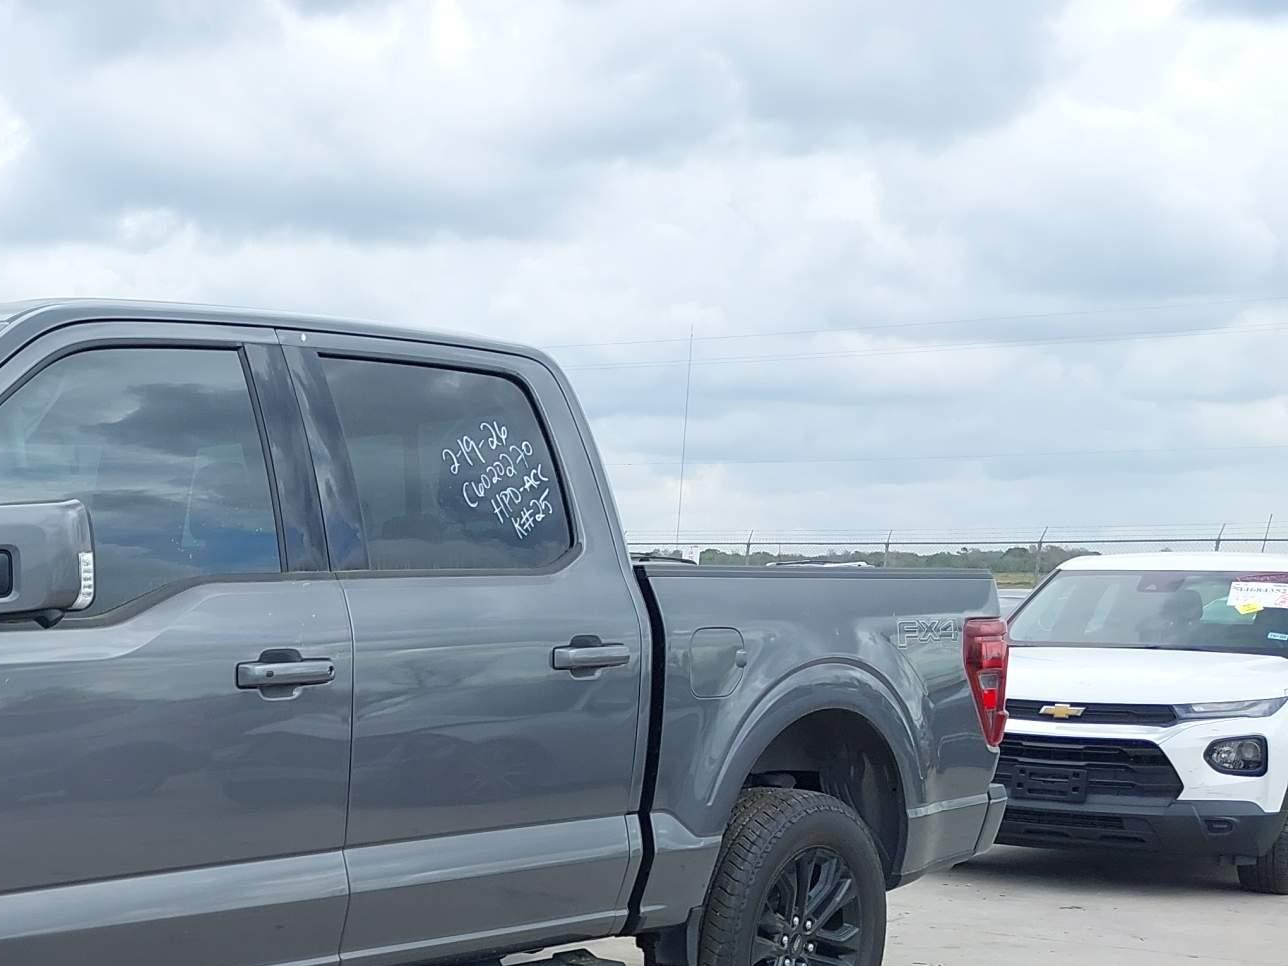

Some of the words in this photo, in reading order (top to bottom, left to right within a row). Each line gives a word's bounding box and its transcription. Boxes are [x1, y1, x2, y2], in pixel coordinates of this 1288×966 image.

[442, 421, 507, 474] 2-19-26
[512, 488, 552, 539] K#25
[897, 620, 958, 649] FX4
